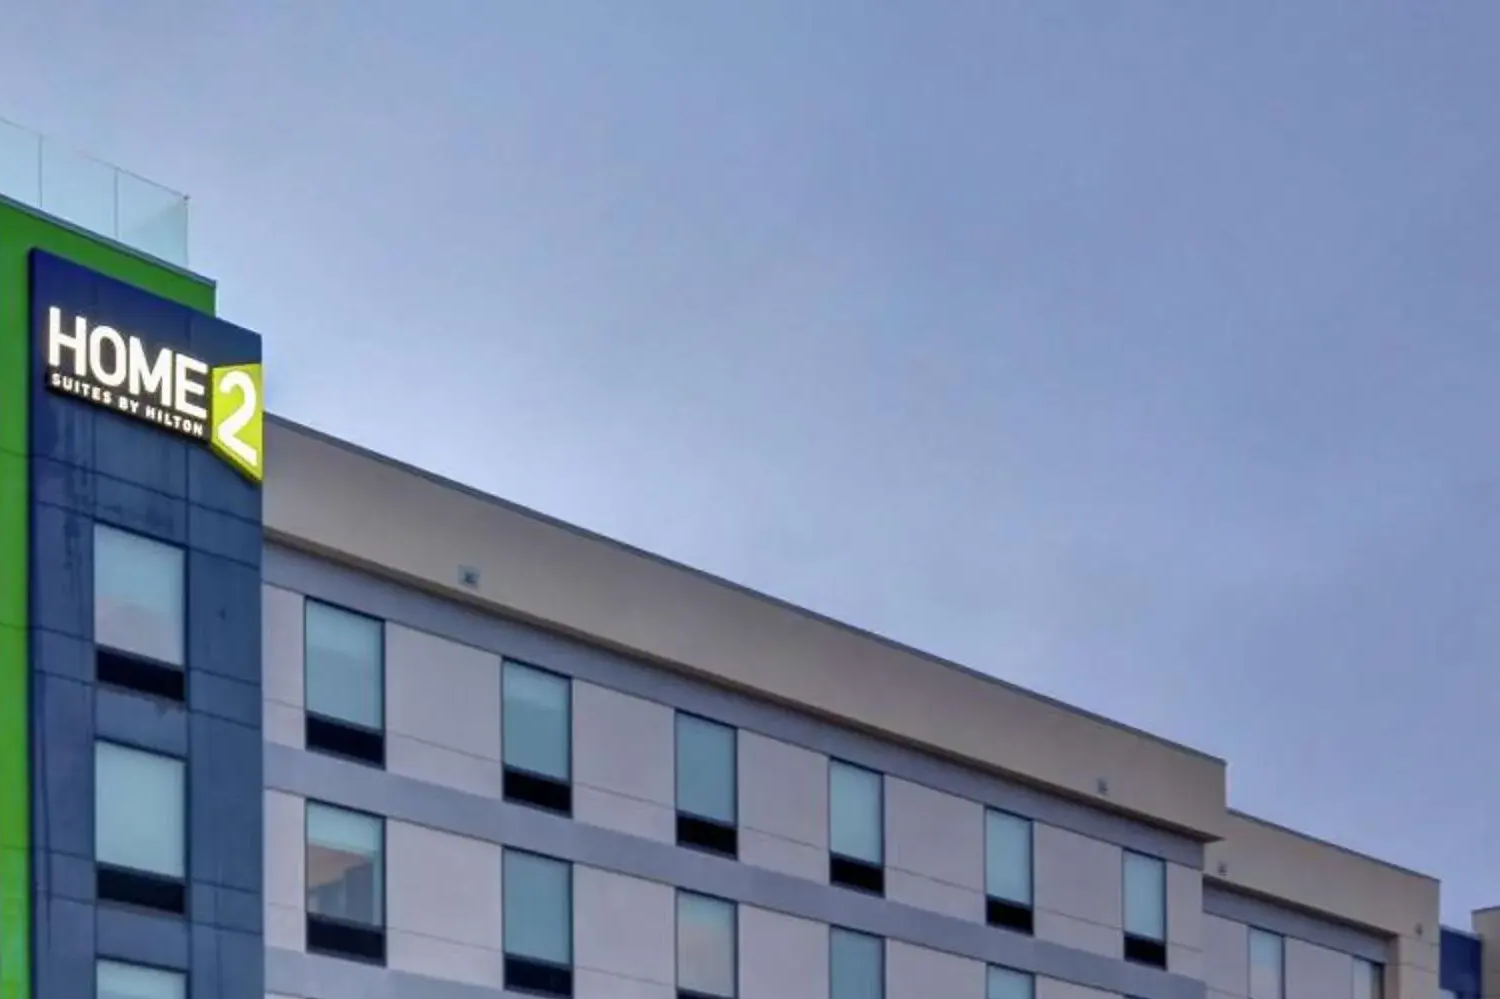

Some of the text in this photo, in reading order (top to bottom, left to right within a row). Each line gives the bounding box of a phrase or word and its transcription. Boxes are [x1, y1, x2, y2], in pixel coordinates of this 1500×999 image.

[48, 306, 258, 467] HOME 2
[52, 373, 204, 437] SUITES BY HILTON
